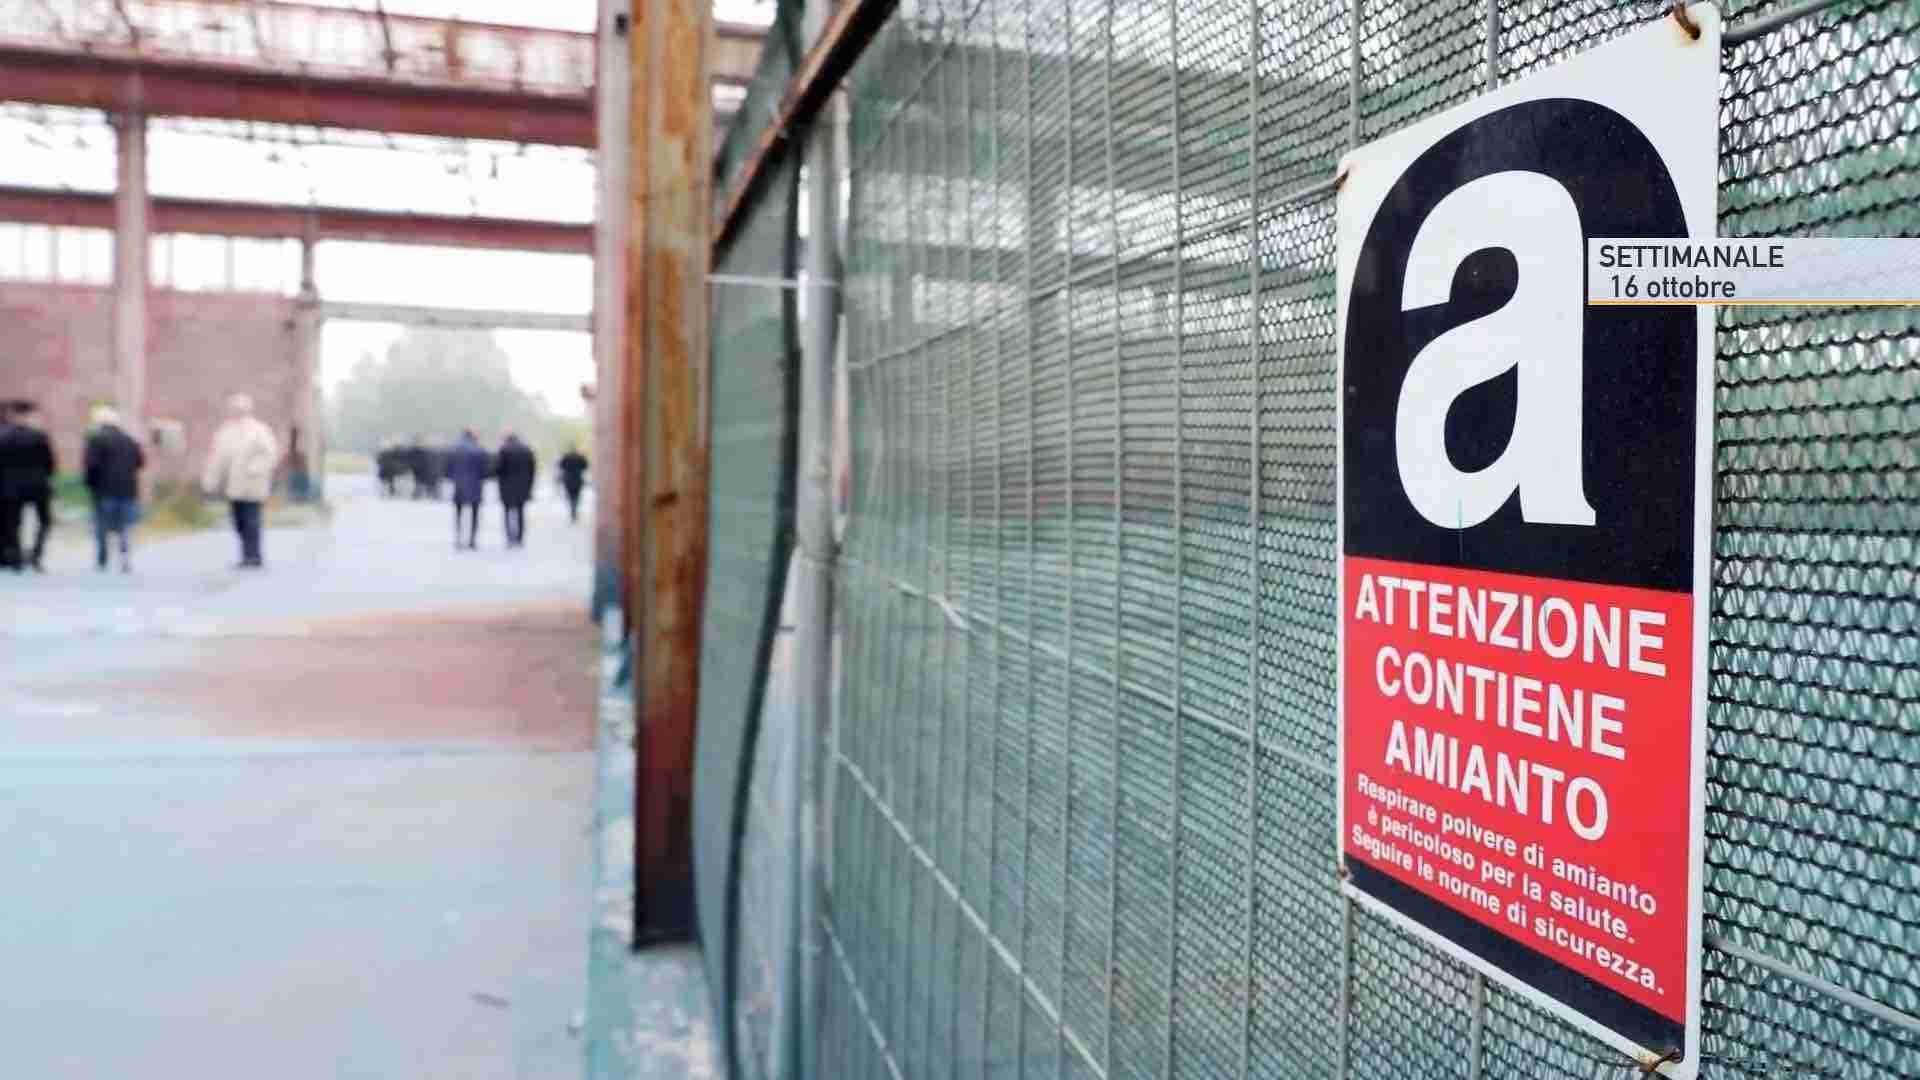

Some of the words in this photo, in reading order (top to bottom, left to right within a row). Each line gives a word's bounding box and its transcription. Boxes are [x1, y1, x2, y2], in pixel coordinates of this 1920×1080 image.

[1395, 169, 1597, 529] a
[1354, 573, 1667, 677] ATTENZIONE
[1375, 645, 1626, 760] CONTIENE
[1357, 773, 1437, 824] Respirare
[1442, 812, 1517, 857] polvere
[1523, 842, 1545, 869] di
[1552, 856, 1657, 915] amianto
[1384, 719, 1608, 841] AMIANTO
[1351, 824, 1413, 871] Seguire
[1417, 854, 1434, 882] le
[1439, 868, 1500, 914] norme
[1507, 903, 1528, 928] di
[1534, 916, 1665, 996] sicurezza.
[1382, 814, 1475, 870] pericoloso
[1481, 861, 1515, 888] per
[1522, 872, 1543, 902] la
[1550, 888, 1636, 944] salute.
